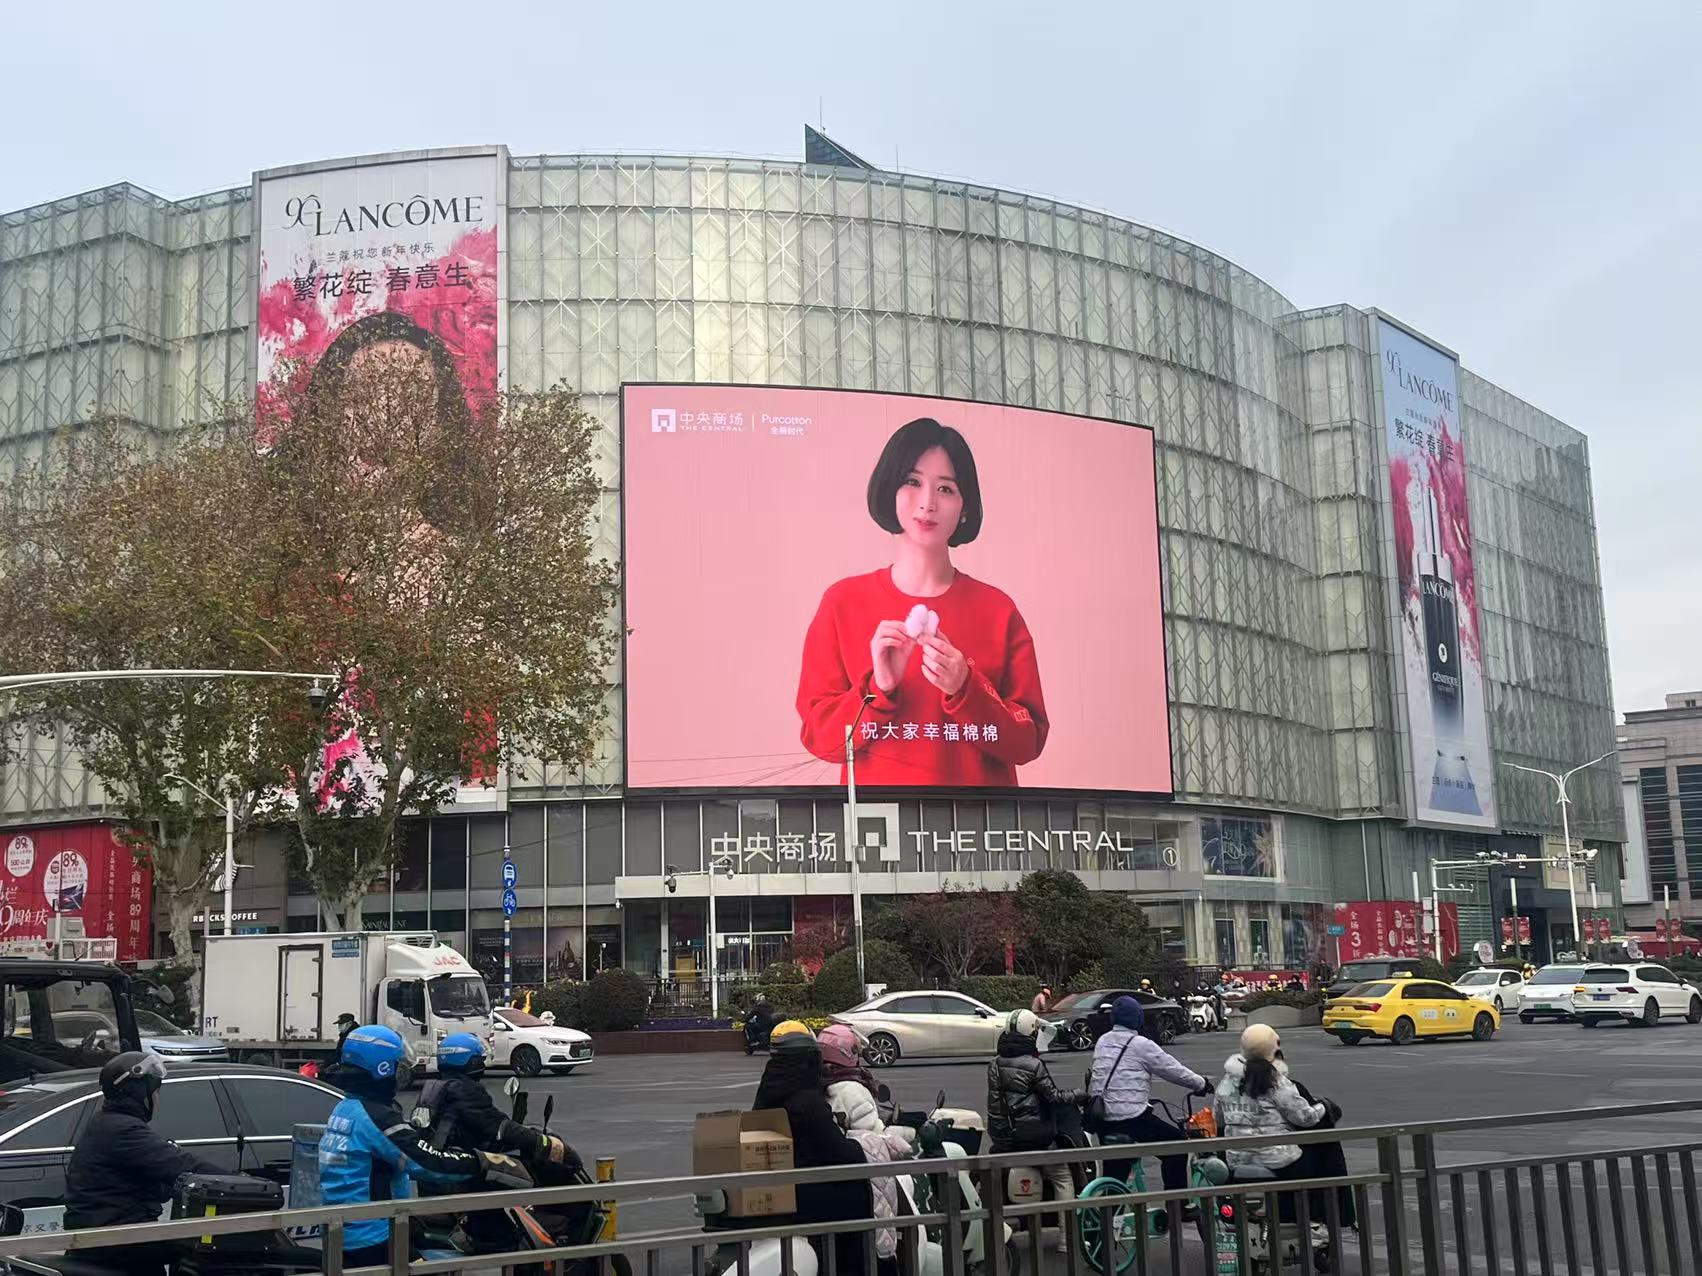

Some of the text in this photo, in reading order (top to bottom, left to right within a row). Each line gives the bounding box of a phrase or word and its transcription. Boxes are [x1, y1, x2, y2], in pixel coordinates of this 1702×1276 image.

[315, 195, 484, 237] LANCÔME
[293, 262, 470, 302] 繁花绽 春意生
[1399, 366, 1454, 413] LANCÔME
[680, 409, 744, 426] 中央商场
[761, 413, 813, 425] Purcotton
[860, 722, 999, 742] 祝大家幸福棉棉
[710, 831, 838, 863] 中央商场
[907, 830, 1134, 853] THE CENTRAL
[231, 912, 258, 921] OFFEE
